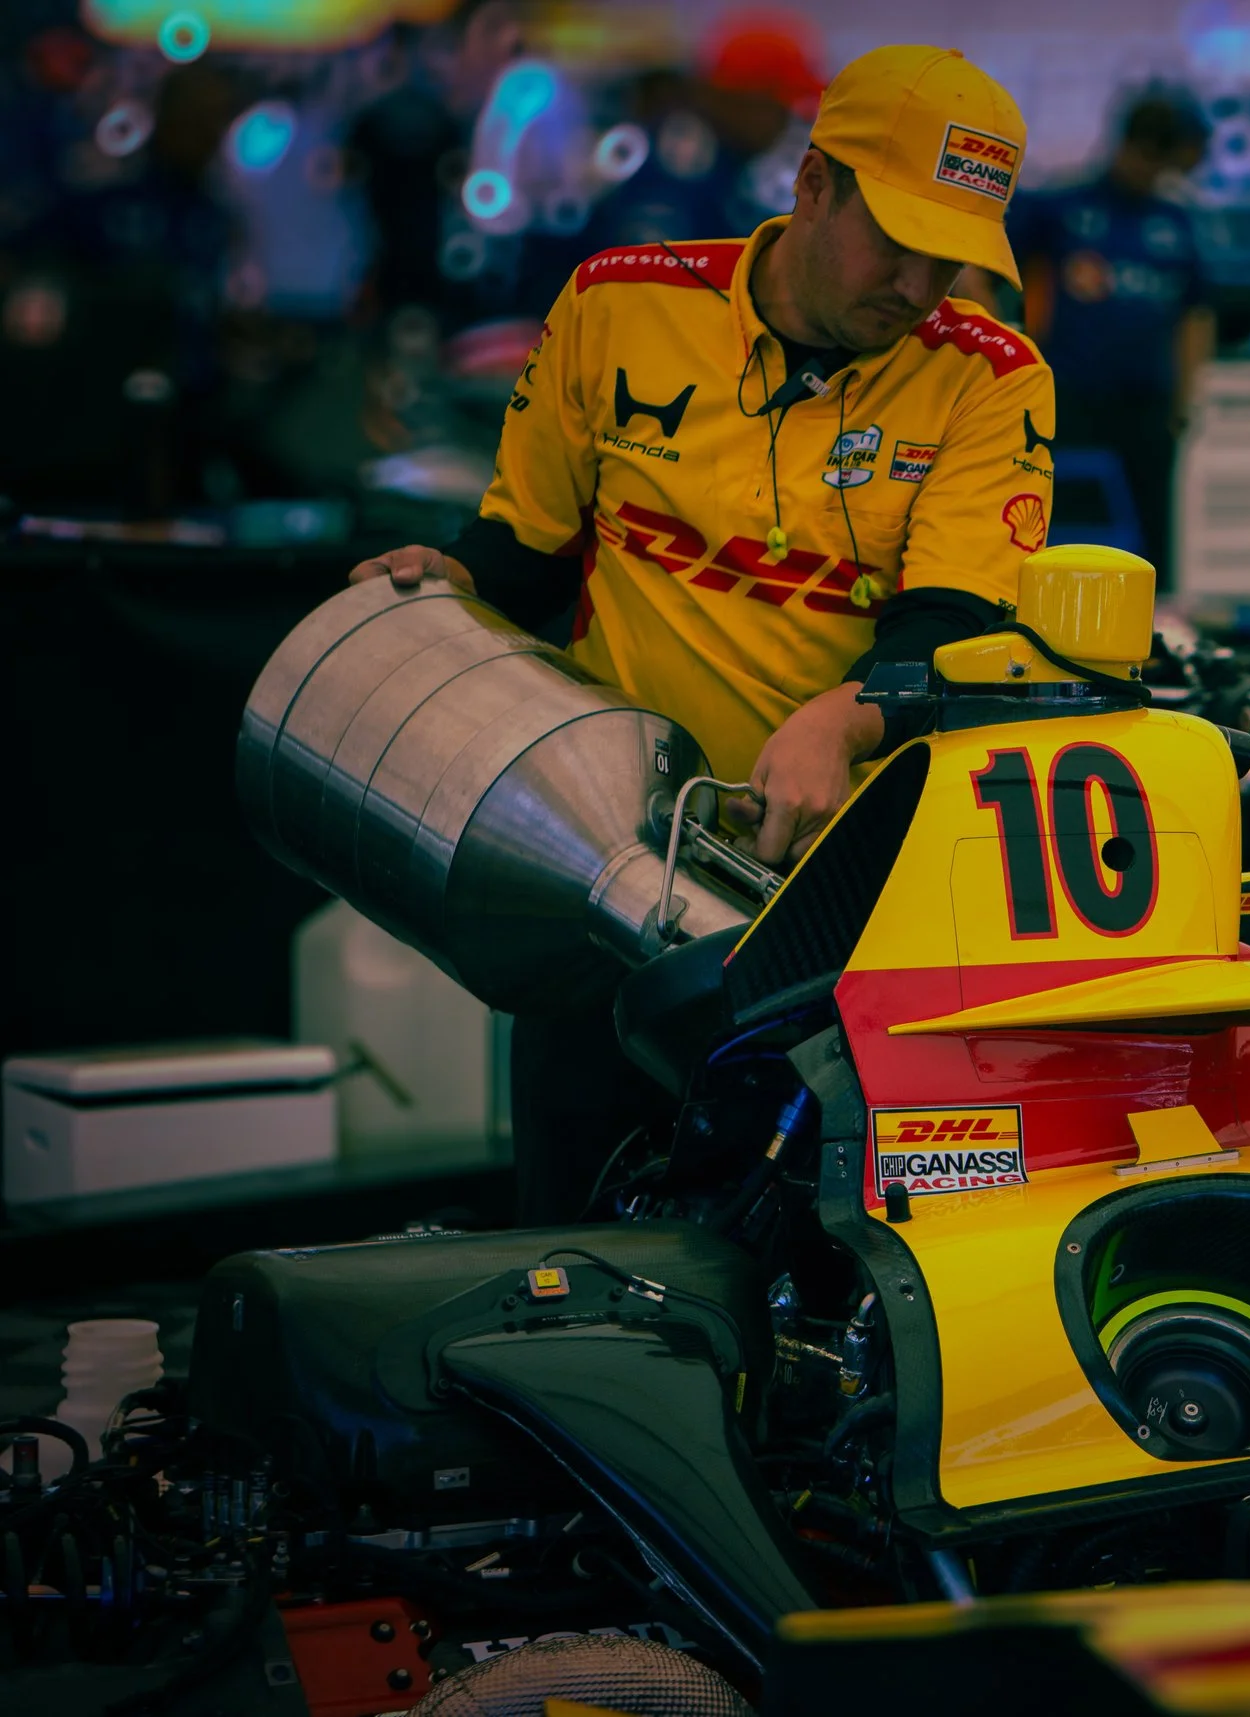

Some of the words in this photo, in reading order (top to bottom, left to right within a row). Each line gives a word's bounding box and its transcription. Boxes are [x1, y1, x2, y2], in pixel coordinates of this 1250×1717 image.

[960, 137, 1014, 167] DHL
[941, 168, 1007, 196] RACING
[588, 254, 709, 275] Firestone
[603, 432, 680, 462] Honda
[904, 448, 936, 461] DH
[616, 501, 882, 618] DHL
[968, 741, 1160, 940] 10
[896, 1118, 1000, 1143] DHL
[883, 1157, 904, 1177] CHIP
[907, 1151, 1018, 1176] GANASSI
